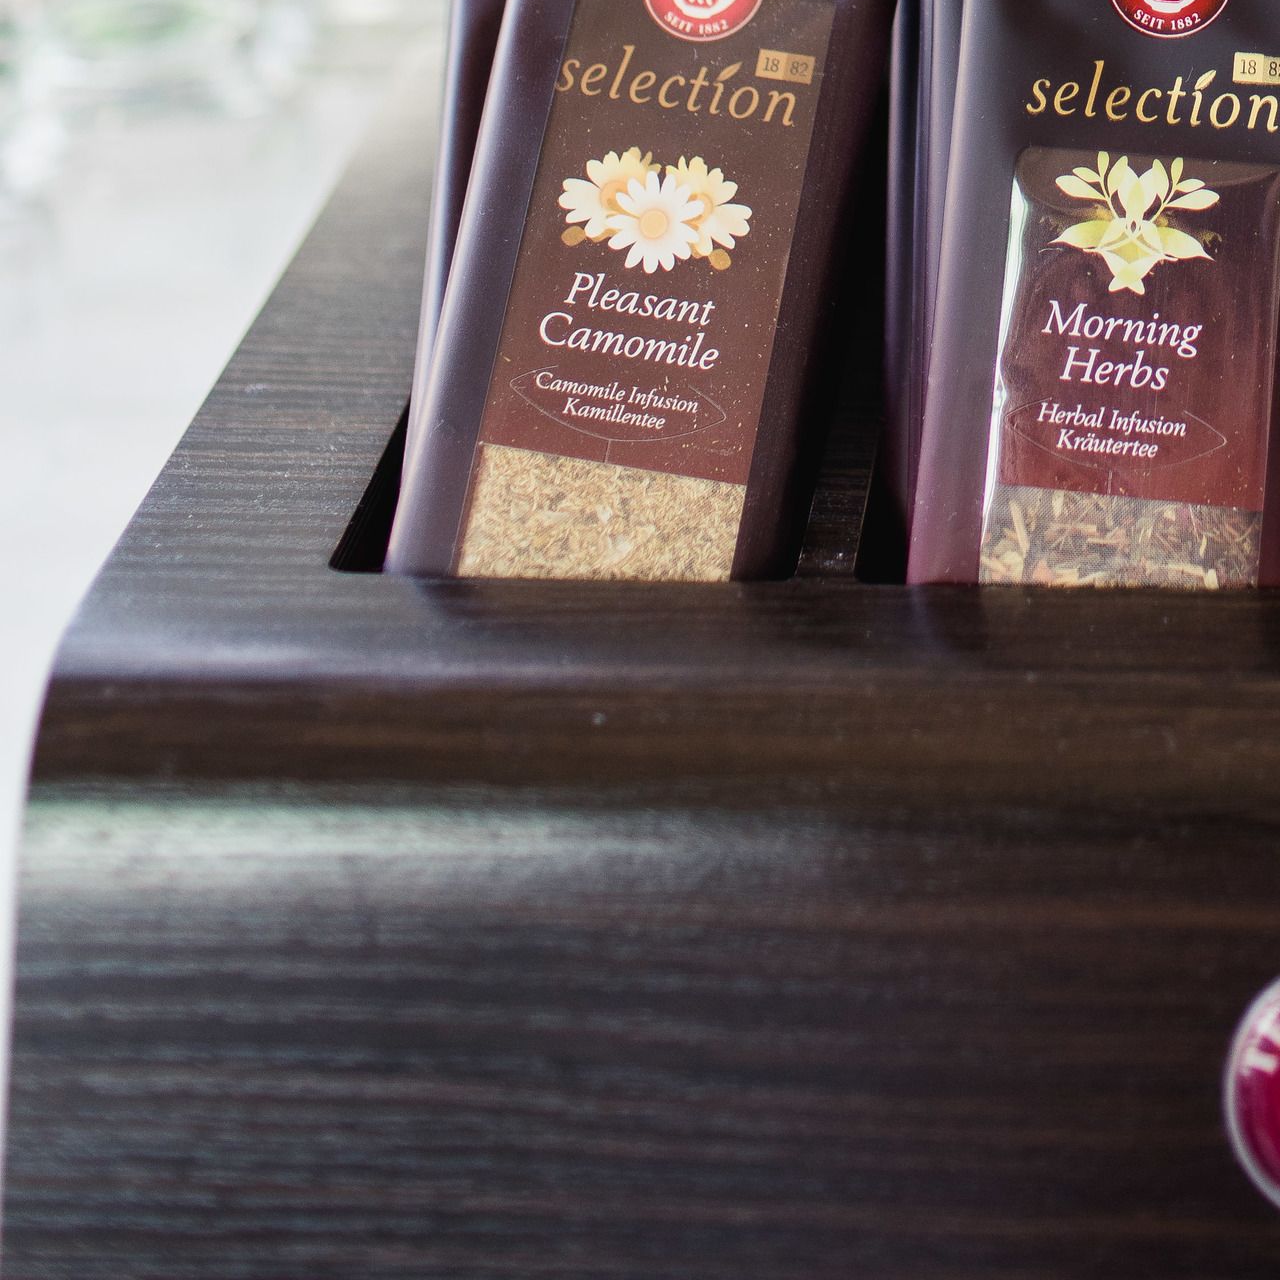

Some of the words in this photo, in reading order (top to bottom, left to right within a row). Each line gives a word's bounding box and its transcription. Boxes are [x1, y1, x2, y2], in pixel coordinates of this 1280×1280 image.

[664, 11, 693, 32] SEIT
[698, 19, 728, 34] 1882
[1134, 9, 1165, 29] SEIT
[1171, 13, 1201, 30] 1882
[555, 45, 796, 126] selection
[1026, 60, 1278, 133] selection
[564, 272, 715, 325] Pleasant
[539, 312, 719, 369] Camomile
[1041, 300, 1202, 358] Morning
[1059, 346, 1169, 390] Herbs
[535, 372, 625, 401] Camomile
[627, 386, 698, 413] Infusion
[562, 397, 666, 429] Kamillentee
[1037, 402, 1105, 428] Herbal
[1109, 409, 1186, 437] Infusion
[1056, 428, 1158, 458] Kräutertee
